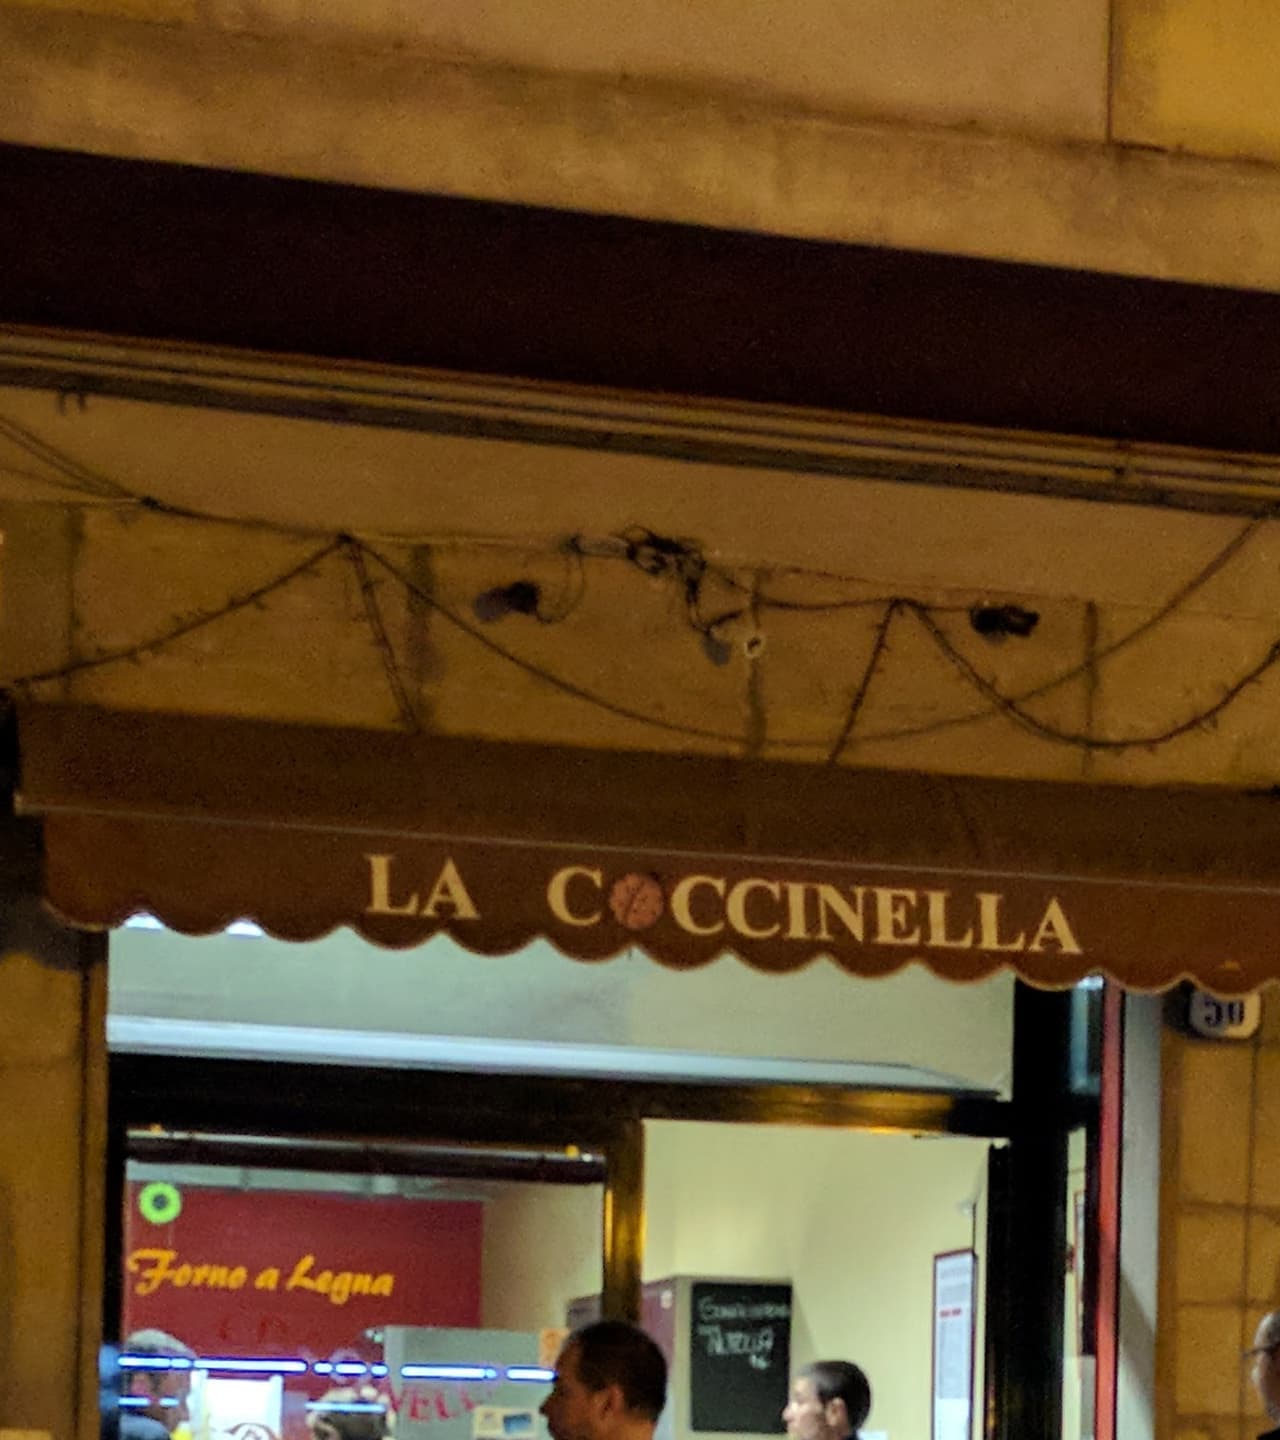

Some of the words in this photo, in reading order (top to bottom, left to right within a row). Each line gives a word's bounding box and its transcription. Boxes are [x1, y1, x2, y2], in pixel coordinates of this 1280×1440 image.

[365, 854, 481, 920] LA
[546, 866, 1083, 955] COCCINELLA
[127, 1247, 248, 1296] Forno
[254, 1265, 281, 1291] a
[286, 1252, 395, 1306] Legna
